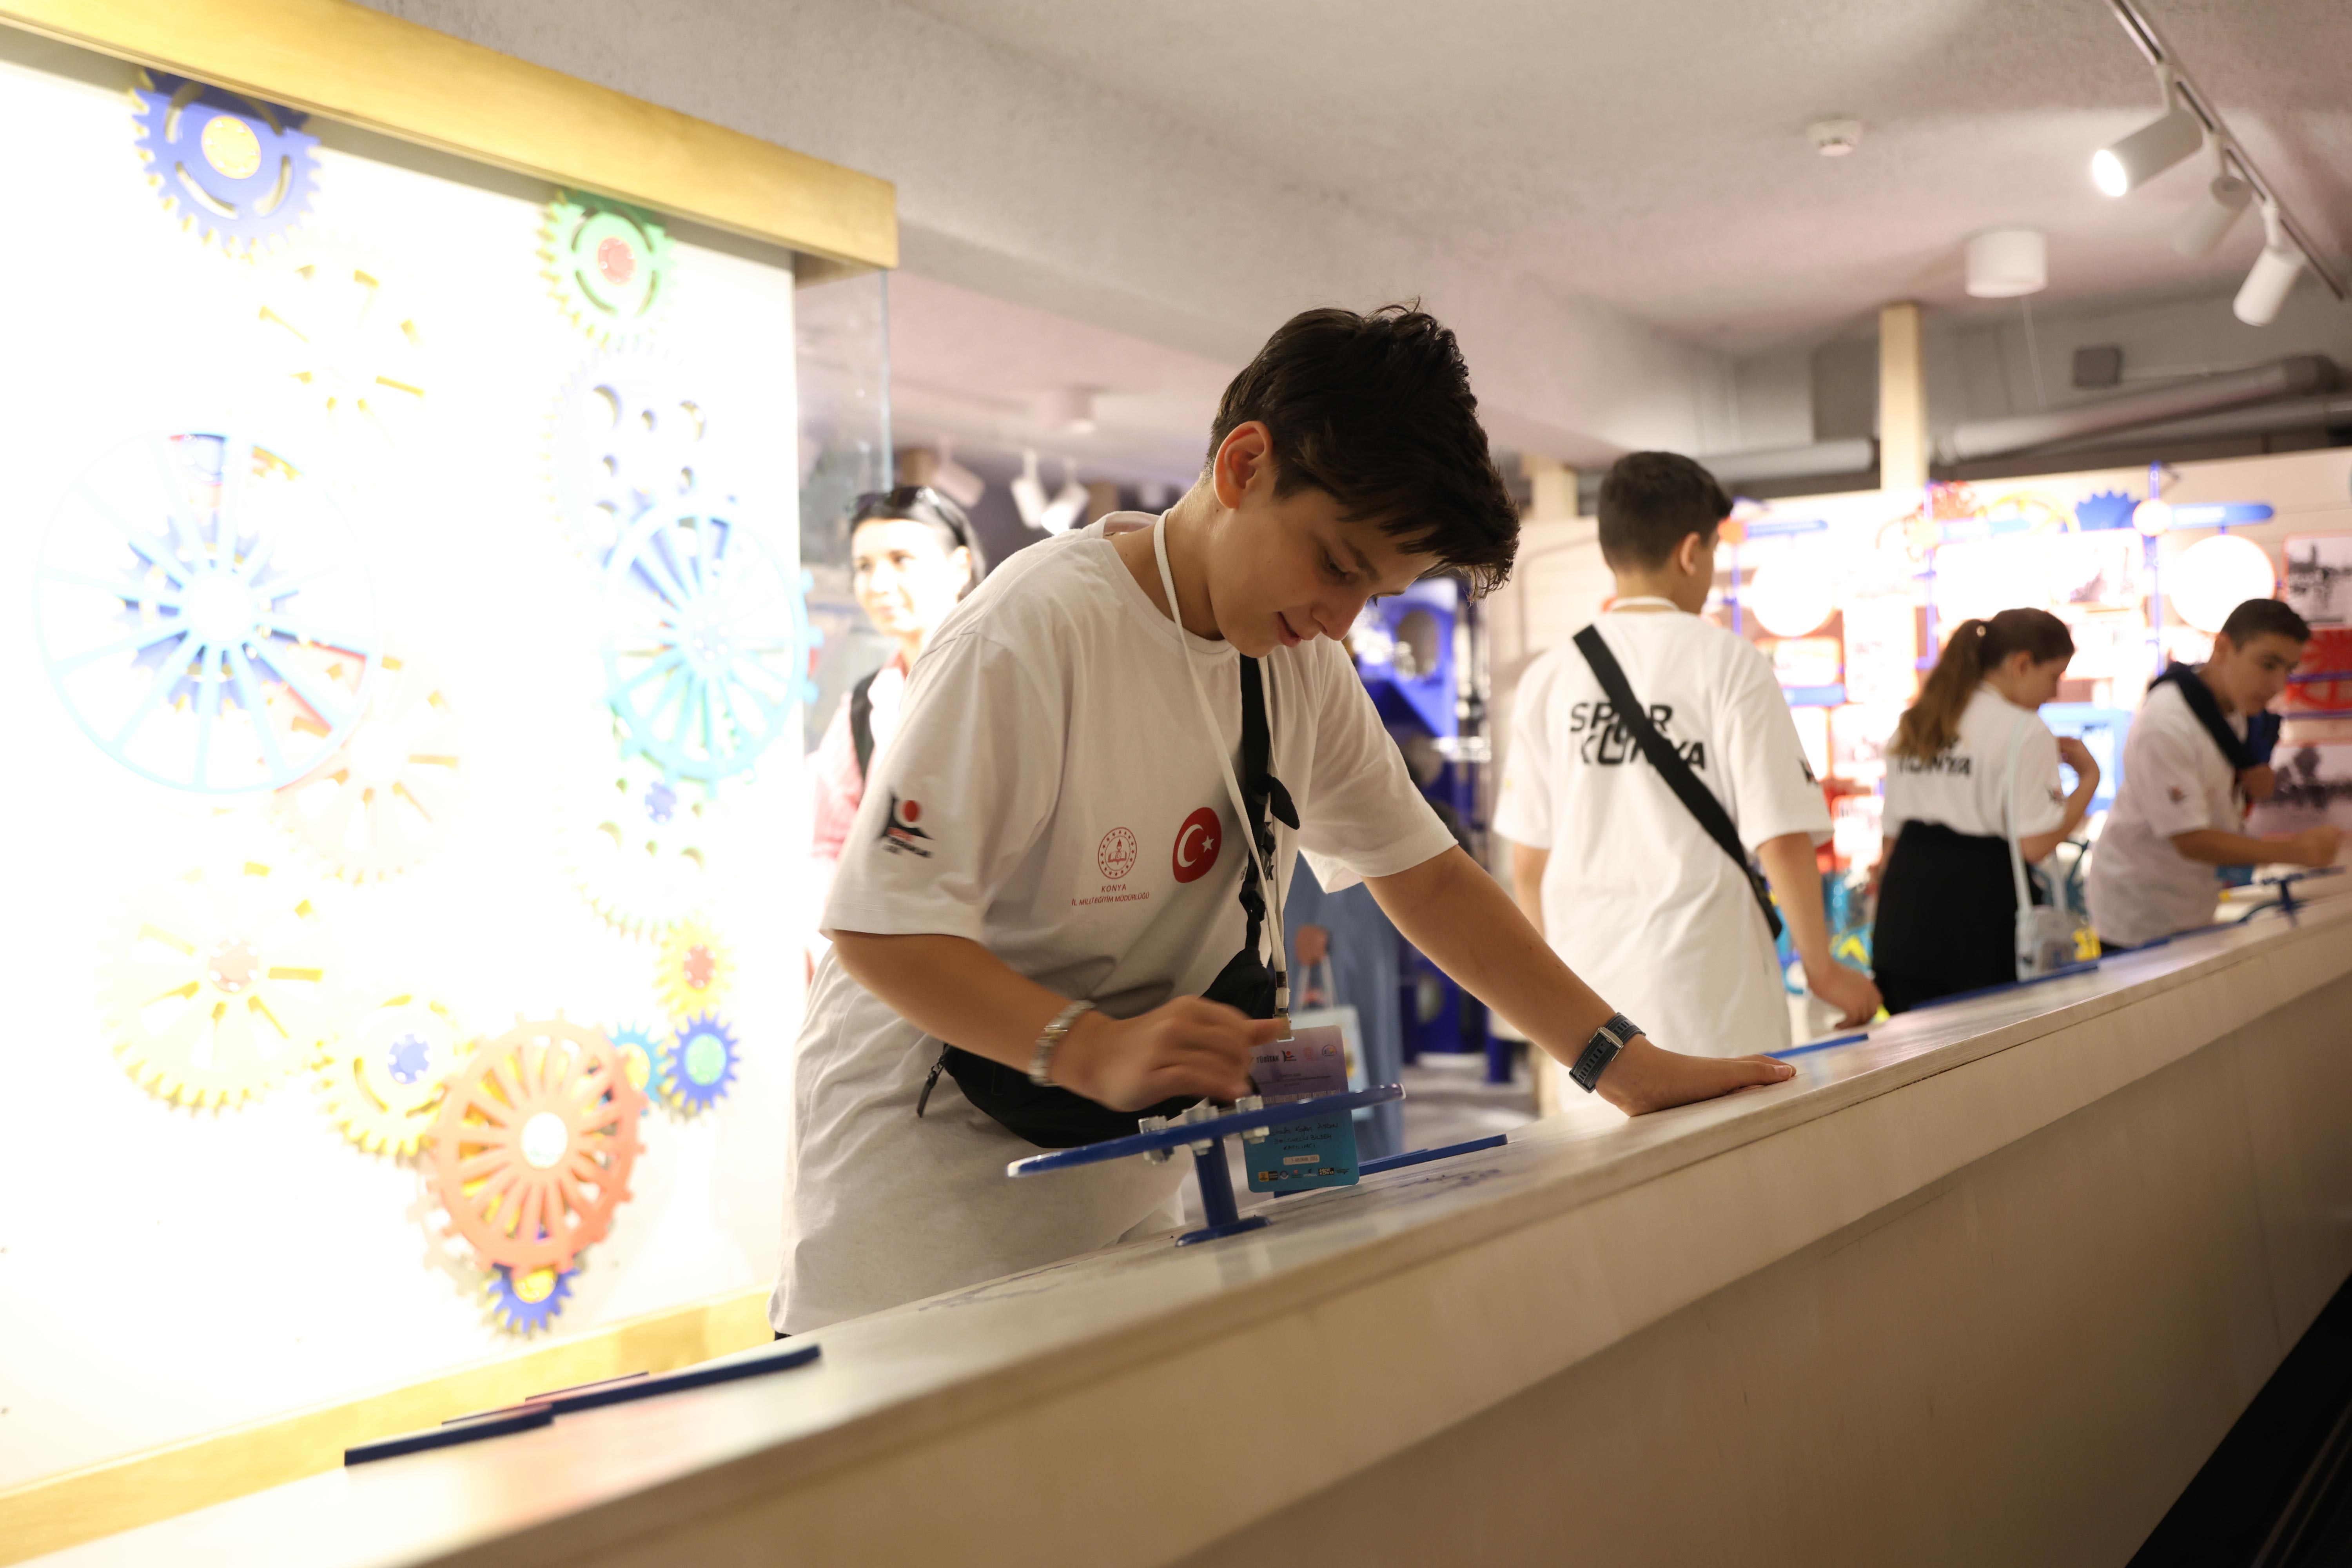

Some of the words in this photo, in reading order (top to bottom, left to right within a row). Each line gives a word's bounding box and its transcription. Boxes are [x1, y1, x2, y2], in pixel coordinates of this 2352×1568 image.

[1581, 725, 1706, 770] KOA
[1101, 884, 1126, 893] KONYA
[1094, 895, 1113, 904] EĞİTİM
[1115, 891, 1149, 902] MÜDÜRLÜĞÜ
